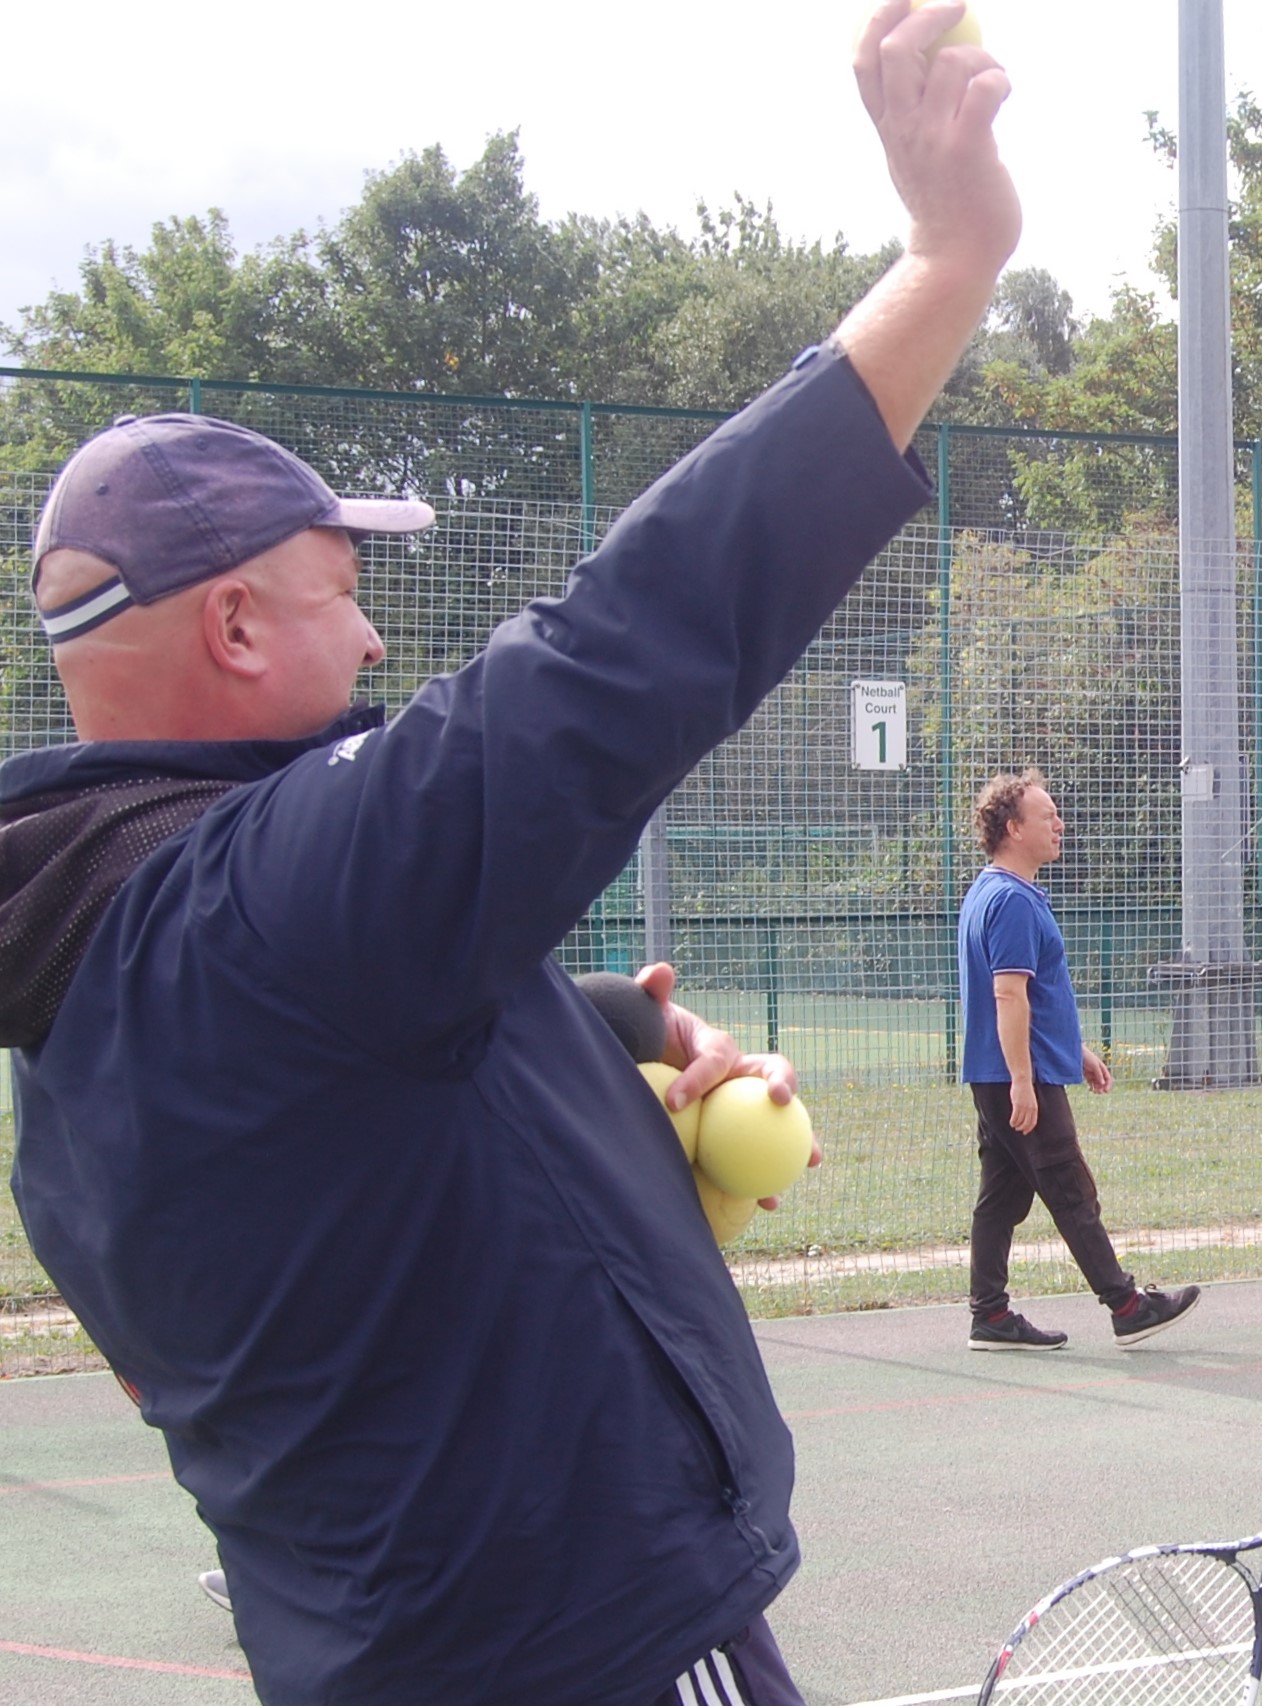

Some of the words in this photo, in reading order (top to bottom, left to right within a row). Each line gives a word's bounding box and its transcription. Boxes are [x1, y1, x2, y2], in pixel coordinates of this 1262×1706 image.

[861, 686, 900, 697] Netball
[865, 702, 897, 714] Court
[871, 721, 887, 763] 1
